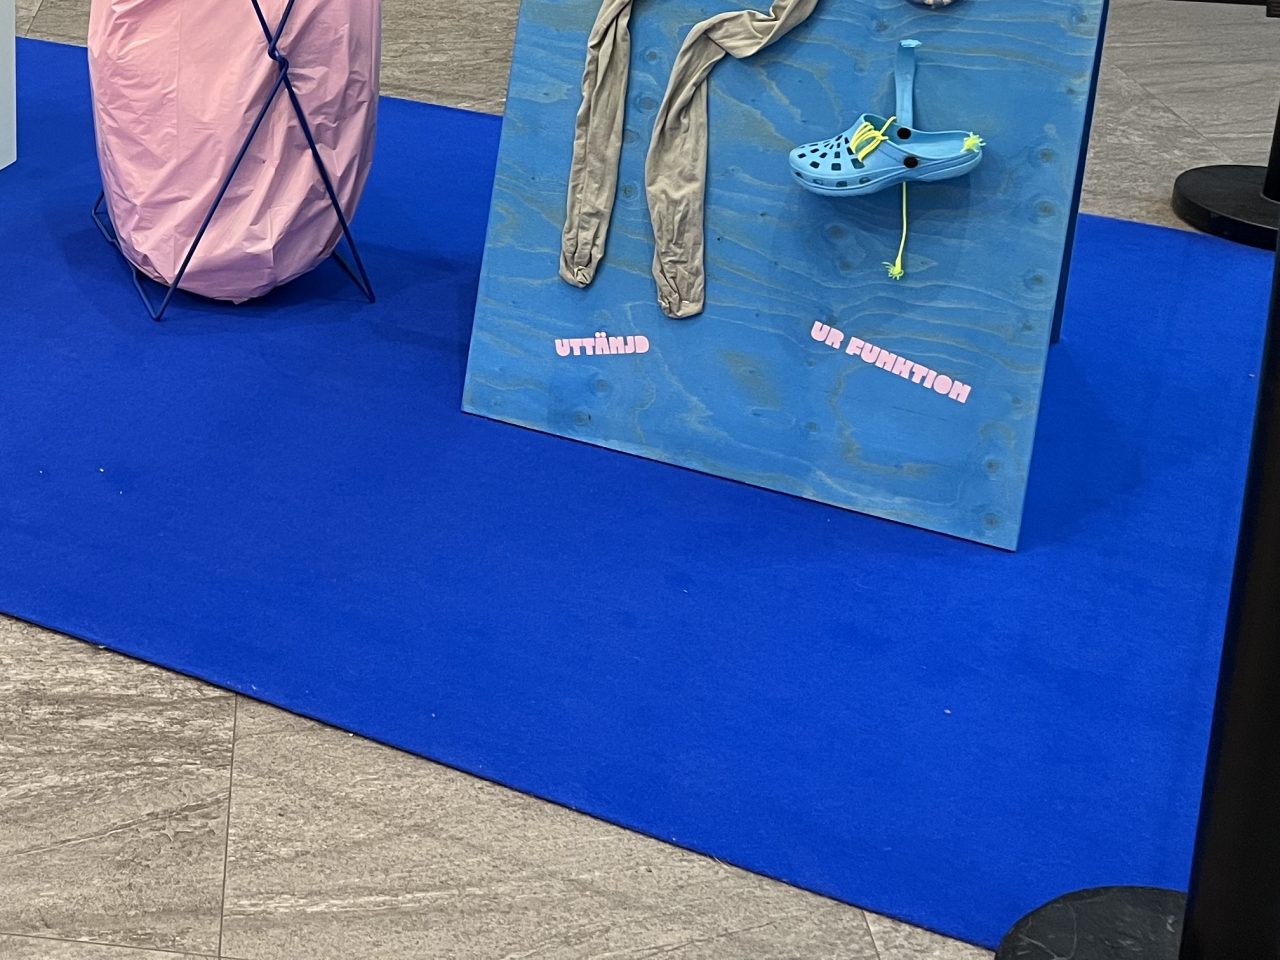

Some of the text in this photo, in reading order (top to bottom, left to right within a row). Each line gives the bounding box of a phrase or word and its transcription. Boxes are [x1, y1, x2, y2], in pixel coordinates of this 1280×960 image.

[554, 331, 650, 357] UTTÄNJD
[810, 320, 972, 404] UR FUNKTION
